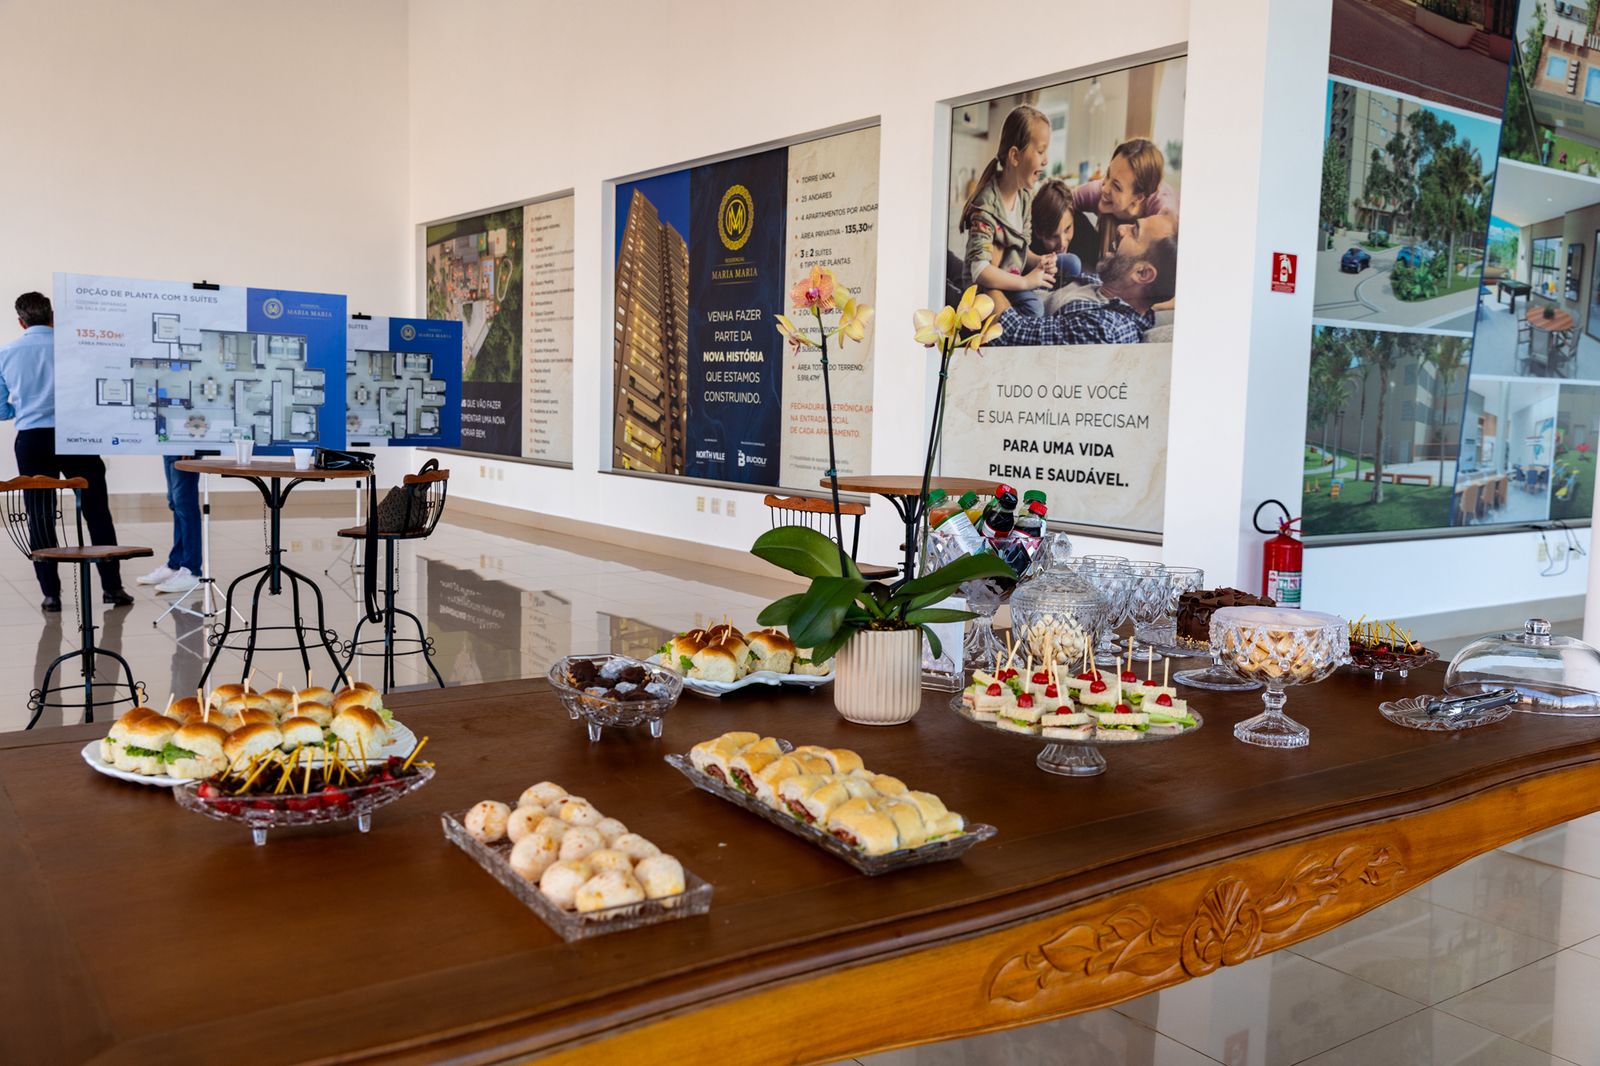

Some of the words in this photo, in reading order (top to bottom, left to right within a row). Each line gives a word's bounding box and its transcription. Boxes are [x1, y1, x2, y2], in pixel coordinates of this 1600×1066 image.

[802, 174, 818, 184] TORRE
[801, 195, 807, 203] 25
[808, 191, 832, 201] ANDARES
[805, 208, 846, 220] APARTAMENTOS
[847, 206, 858, 215] POR
[859, 203, 879, 213] ANDAR
[815, 228, 840, 237] PRIVATIVA
[800, 249, 805, 258] 3
[809, 248, 814, 257] 2
[820, 259, 827, 267] DE
[827, 257, 851, 267] PLANTAS
[712, 269, 734, 280] MARIA
[735, 267, 758, 278] MARIA
[76, 287, 108, 297] OPÇÃO
[111, 290, 122, 298] DE
[125, 291, 159, 300] PLANTA
[190, 294, 218, 304] SUÍTES
[288, 308, 309, 316] MARIA
[310, 310, 332, 318] MARIA
[707, 310, 734, 322] VENHA
[735, 309, 761, 321] FAZER
[714, 331, 739, 342] PARTE
[740, 330, 753, 342] DA
[703, 351, 725, 362] NOVA
[726, 348, 764, 363] HISTÓRIA
[706, 370, 722, 382] QUE
[723, 371, 760, 383] ESTAMOS
[704, 390, 762, 404] CONSTRUINDO.
[997, 384, 1033, 399] TUDO
[1037, 384, 1048, 399] O
[1052, 384, 1083, 400] QUE
[1087, 382, 1128, 400] VOCÊ
[467, 399, 476, 408] QUE
[476, 398, 486, 409] VÃO
[487, 400, 502, 410] FAZER
[790, 402, 824, 411] FECHADURA
[481, 415, 492, 424] UMA
[492, 416, 506, 425] NOVA
[799, 415, 827, 423] ENTRADA
[831, 416, 849, 425] OCIAL
[977, 409, 985, 423] E
[989, 410, 1014, 424] SUA
[1018, 408, 1070, 427] FAMÍLIA
[1075, 412, 1150, 429] PRECISAM
[799, 427, 814, 435] CADA
[1003, 438, 1039, 454] PARA
[1043, 440, 1075, 456] UMA
[1079, 442, 1115, 458] VIDA
[695, 450, 712, 459] NORTH
[713, 451, 725, 461] VILLE
[989, 463, 1031, 480] PLENA
[1036, 466, 1044, 480] E
[1047, 467, 1129, 488] SAUDÁVEL.
